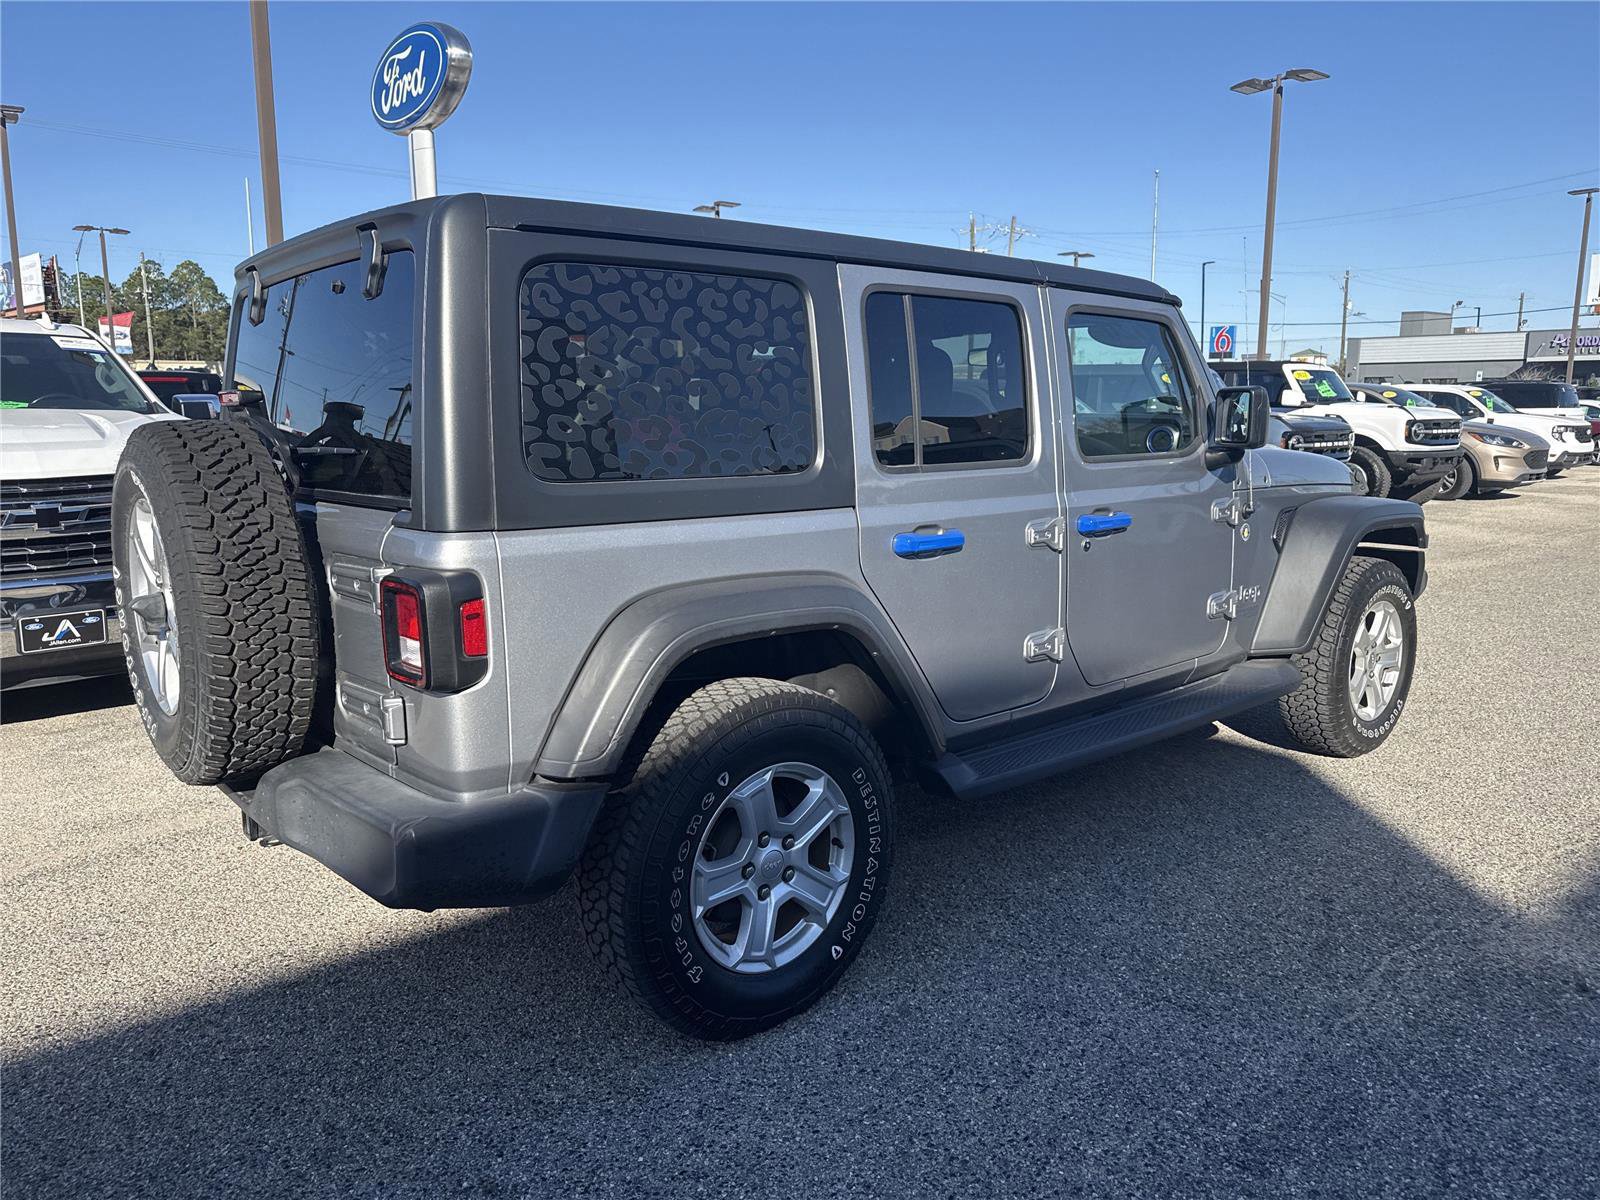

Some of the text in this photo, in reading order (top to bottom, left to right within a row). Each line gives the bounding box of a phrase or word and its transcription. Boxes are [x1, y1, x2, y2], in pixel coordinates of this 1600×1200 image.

[381, 45, 426, 115] Ford
[1213, 325, 1232, 353] 6
[1239, 585, 1259, 602] Jeep
[670, 792, 715, 983] Firestone
[841, 767, 882, 942] DESTINATION
